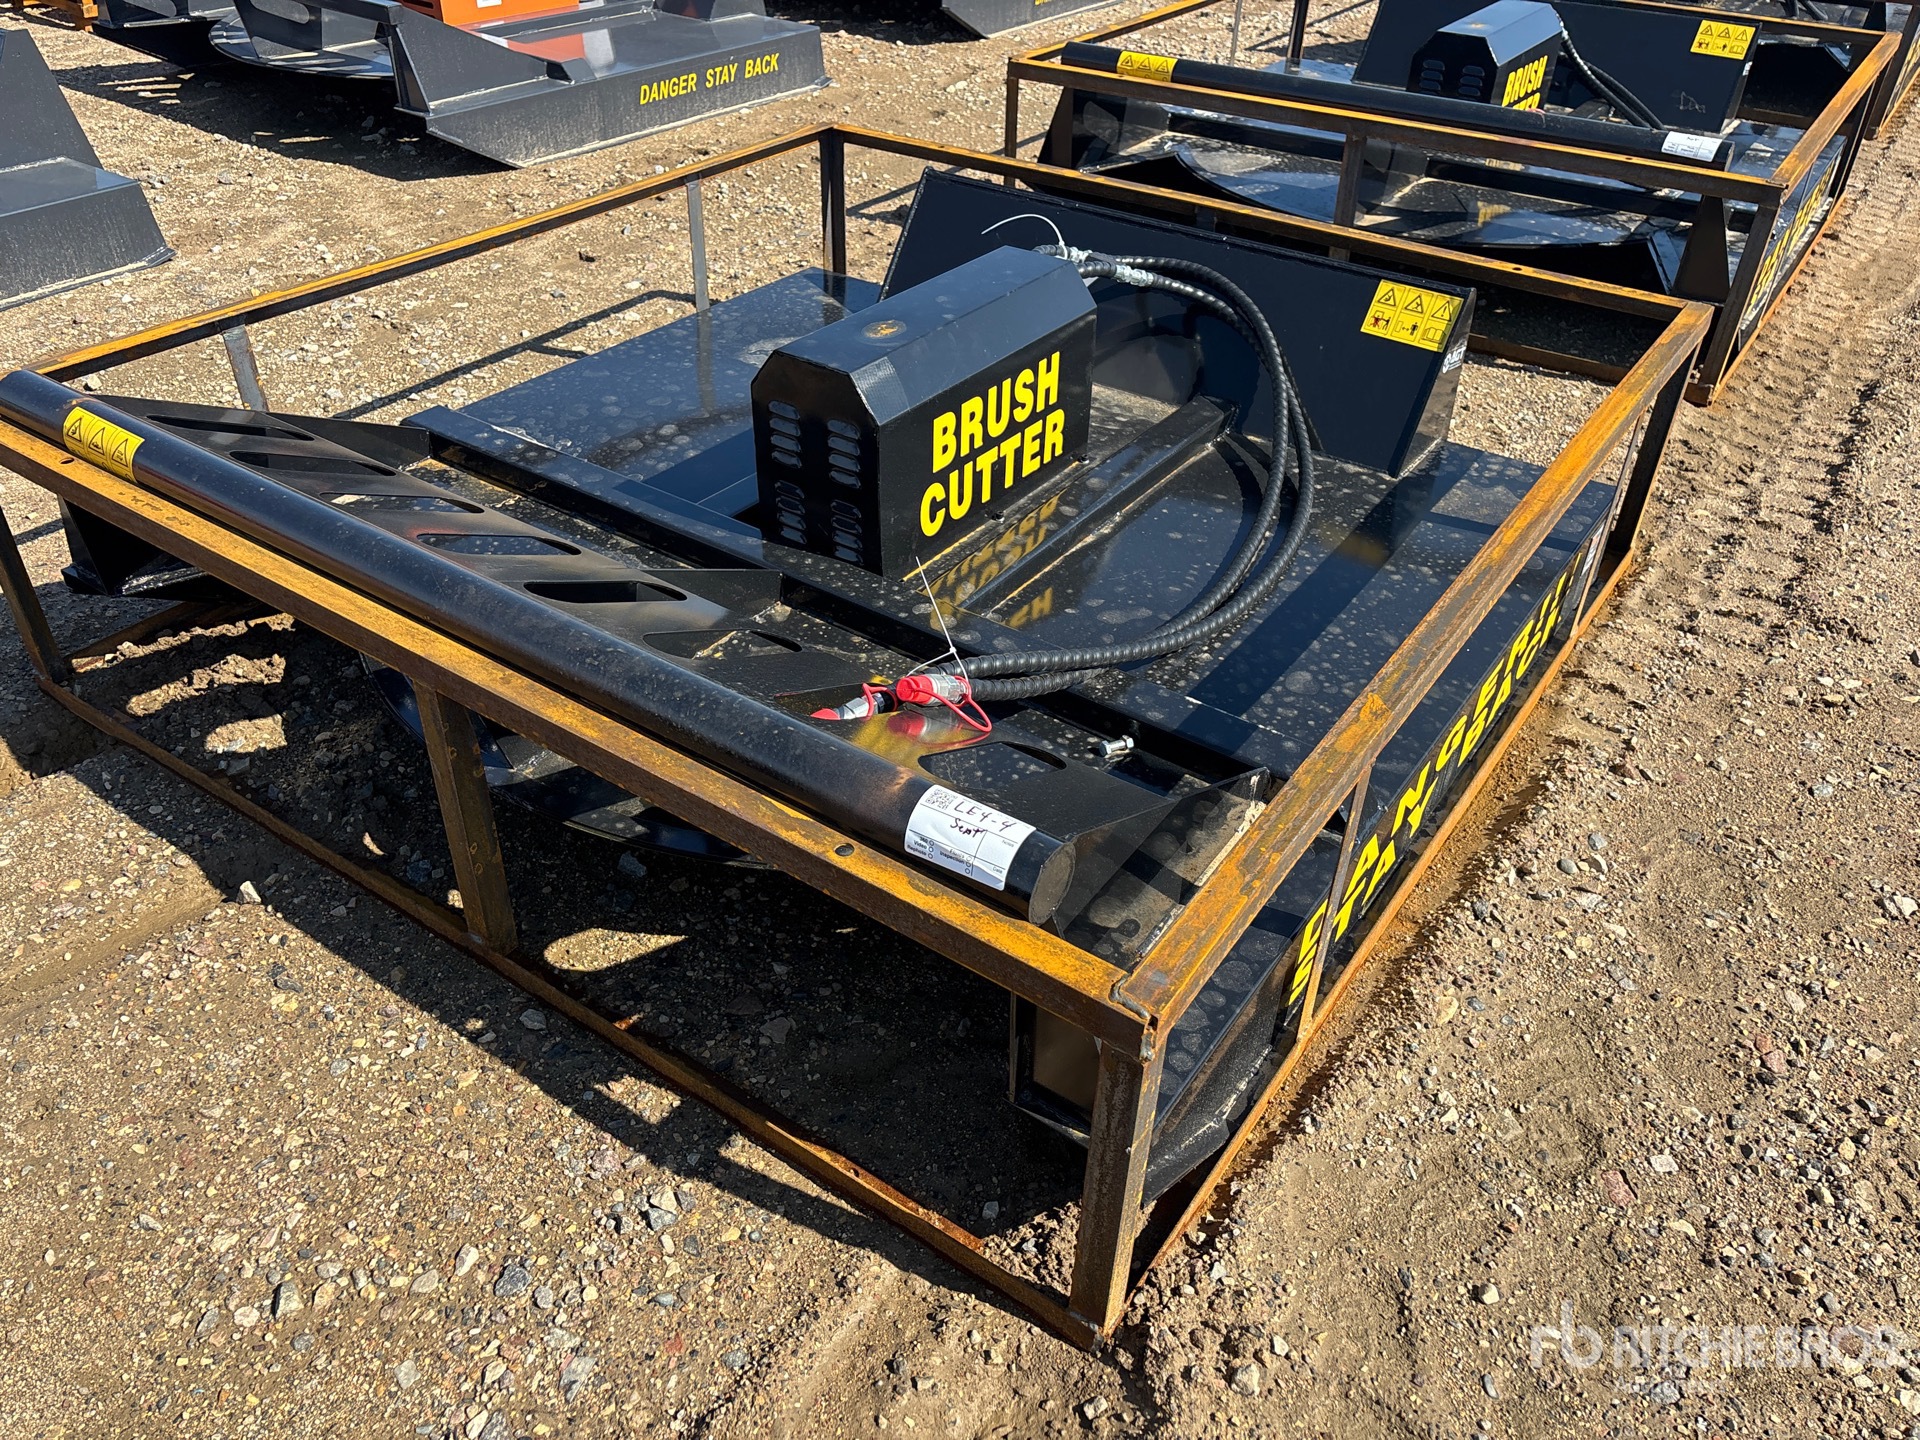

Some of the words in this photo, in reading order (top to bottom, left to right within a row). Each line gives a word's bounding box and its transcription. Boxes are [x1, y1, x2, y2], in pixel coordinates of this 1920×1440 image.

[640, 73, 697, 105] DANGER
[705, 63, 738, 88] STAY
[744, 53, 779, 78] BACK
[1502, 55, 1548, 107] BRUSH
[933, 351, 1060, 474] BRUSH
[920, 409, 1065, 537] CUTTER
[913, 840, 928, 850] Video
[1289, 777, 1438, 1006] STAY
[1458, 606, 1561, 768] BACK
